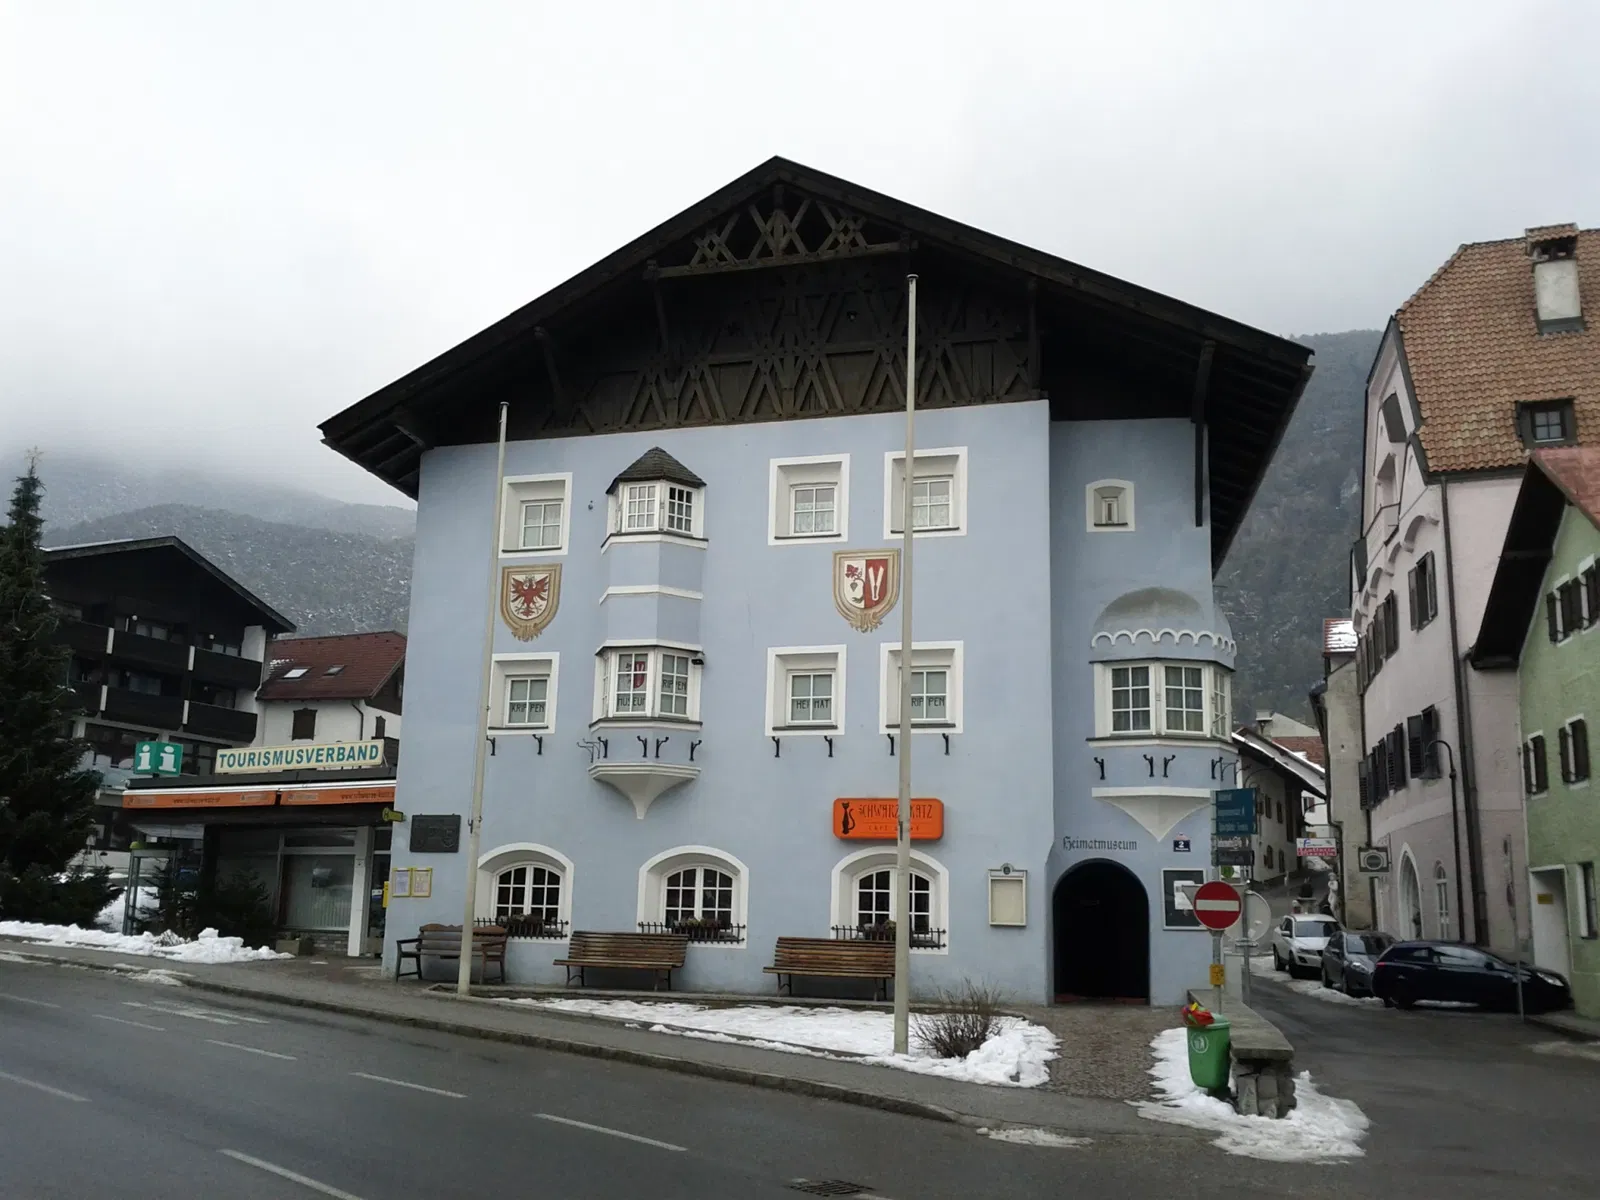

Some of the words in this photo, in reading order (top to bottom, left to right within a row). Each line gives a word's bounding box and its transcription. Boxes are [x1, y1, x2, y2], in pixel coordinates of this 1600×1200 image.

[911, 697, 945, 707] RIPPEN
[219, 744, 379, 768] TOURISMUSVERBAND
[859, 804, 899, 819] SCHWARZ
[1063, 836, 1137, 851] Heimatmuseum
[1178, 840, 1185, 848] 2
